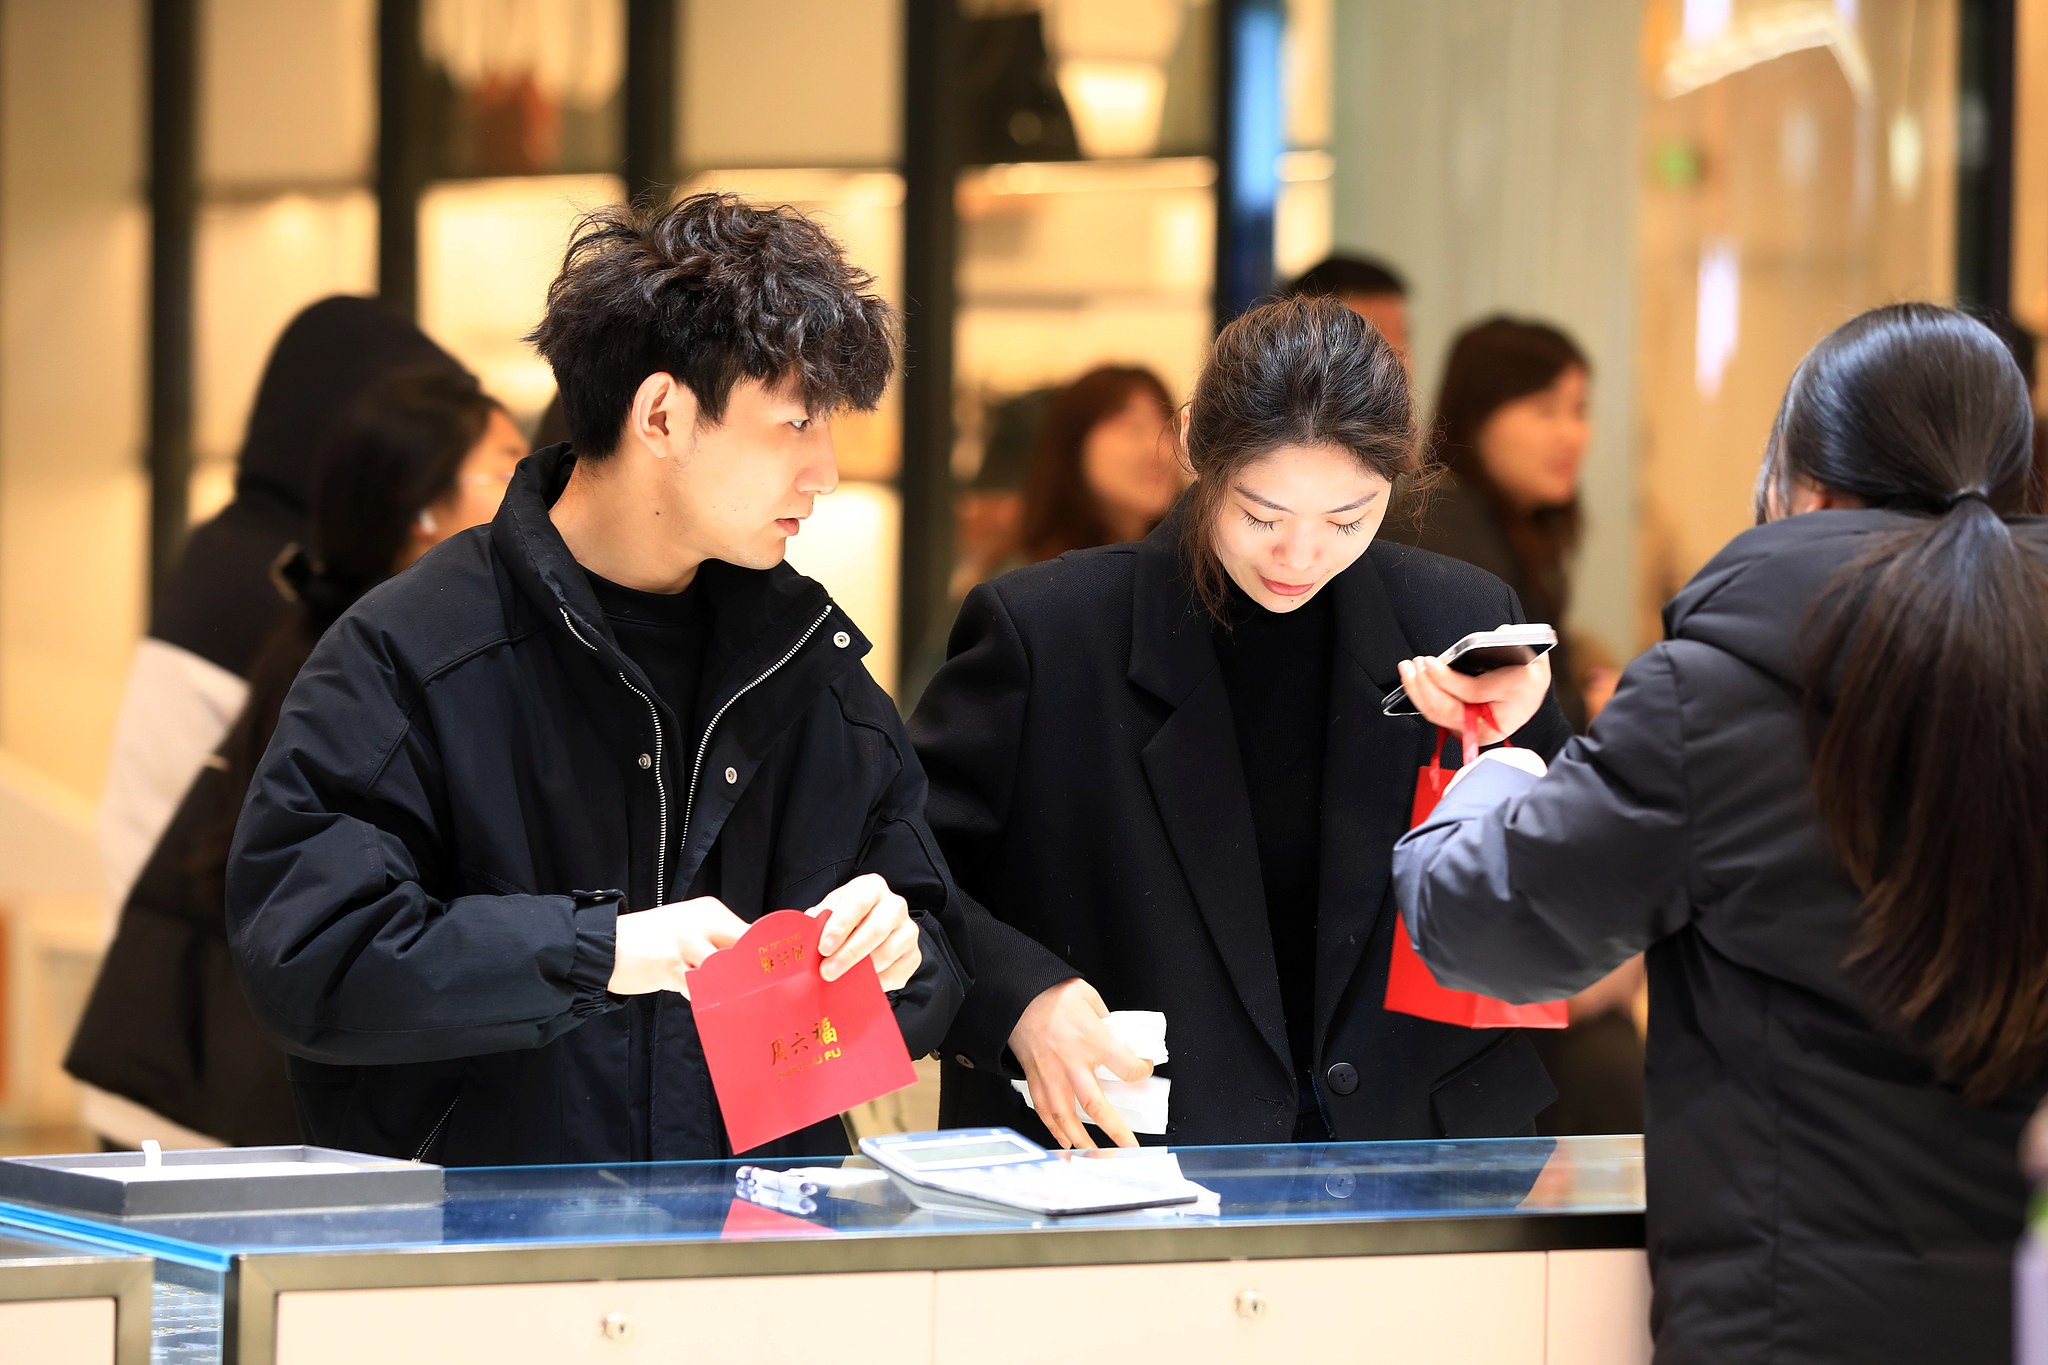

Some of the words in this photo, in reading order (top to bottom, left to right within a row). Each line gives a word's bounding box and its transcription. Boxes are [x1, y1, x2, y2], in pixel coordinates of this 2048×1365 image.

[771, 1016, 838, 1067] 周六福
[824, 1047, 842, 1061] FU
